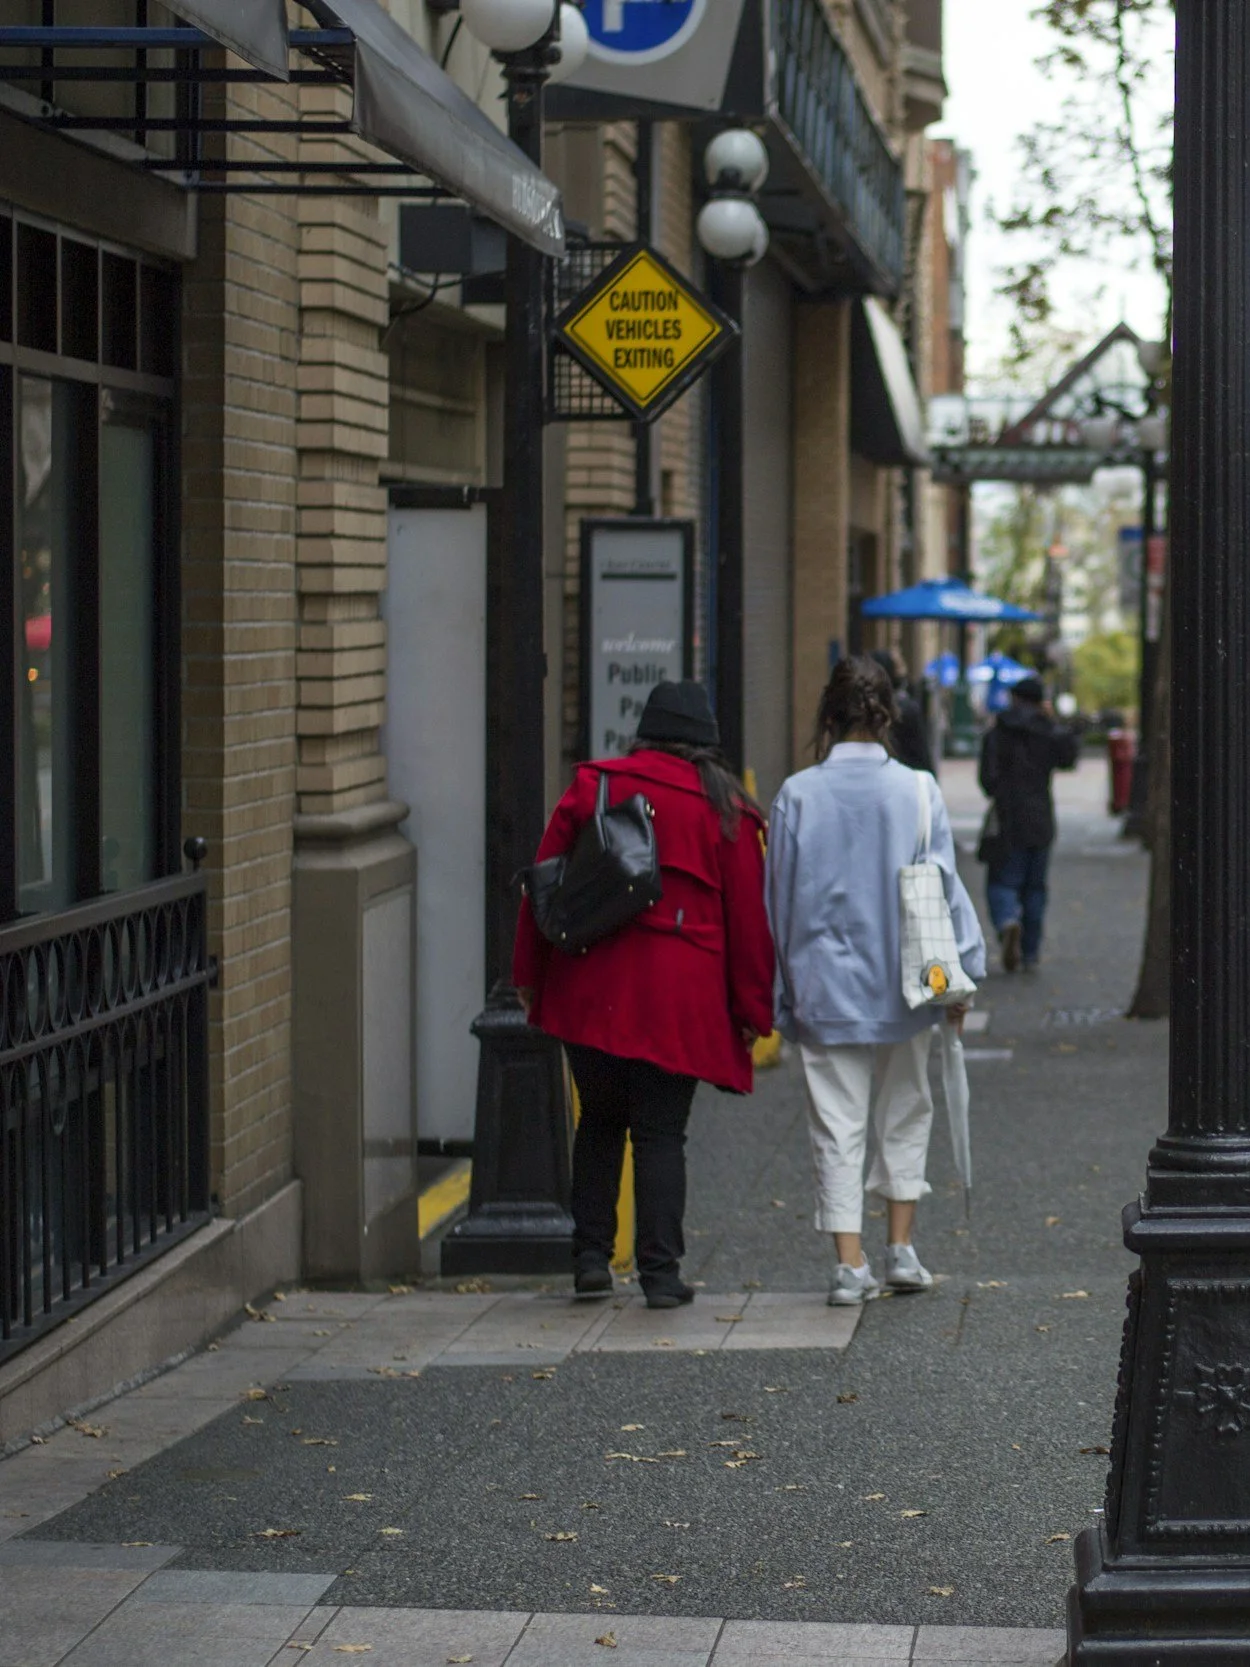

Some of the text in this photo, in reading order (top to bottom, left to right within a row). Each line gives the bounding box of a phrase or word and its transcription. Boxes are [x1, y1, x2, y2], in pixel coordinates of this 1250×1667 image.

[609, 290, 678, 311] CAUTION
[605, 319, 682, 339] VEHICLES
[614, 347, 674, 368] EXITING
[602, 631, 675, 653] welcome
[608, 662, 667, 684] Public
